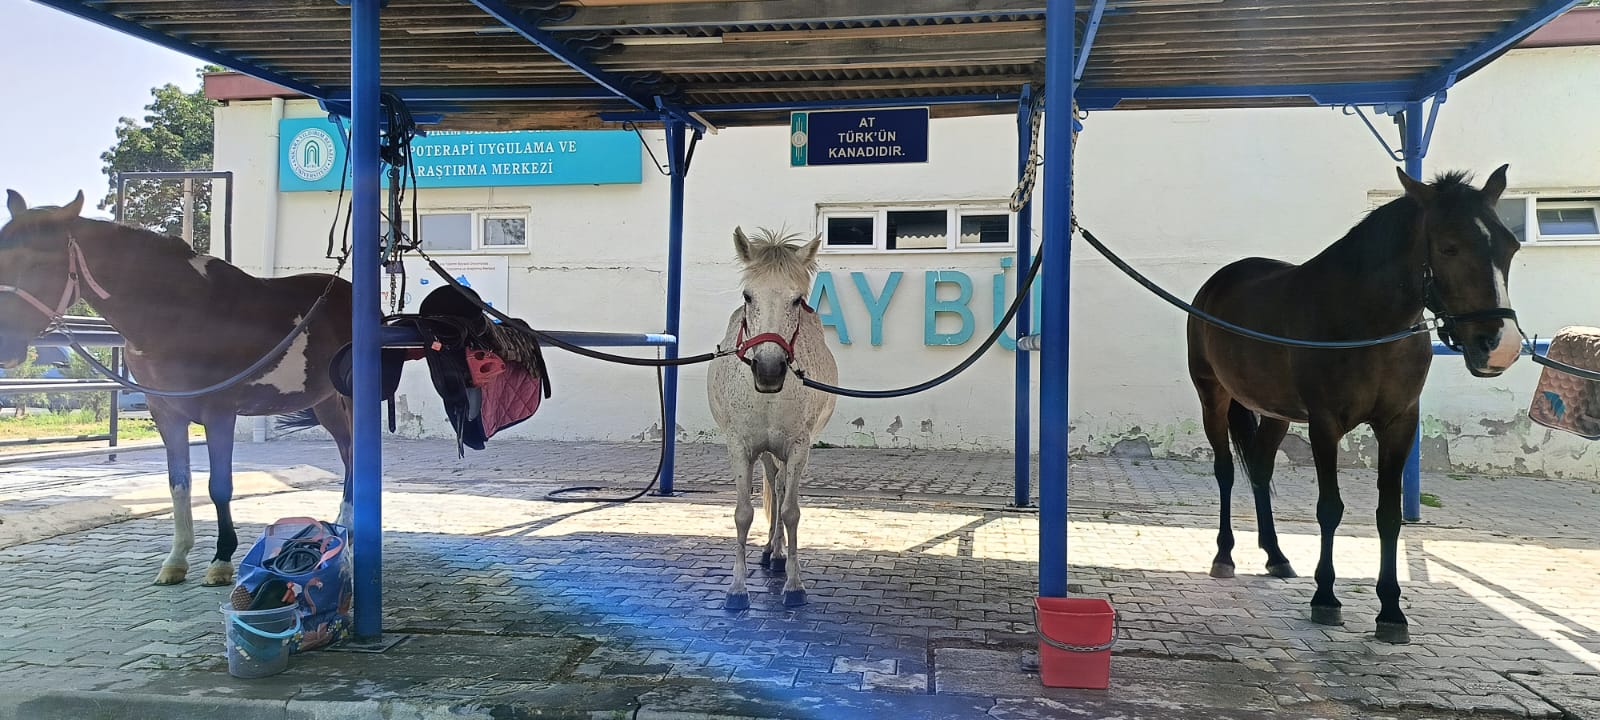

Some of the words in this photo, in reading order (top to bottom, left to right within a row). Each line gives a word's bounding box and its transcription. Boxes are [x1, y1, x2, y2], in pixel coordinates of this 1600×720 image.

[858, 117, 876, 128] AT
[838, 130, 896, 144] TÜRK'ÜN
[478, 141, 555, 155] UYGULAMA
[559, 140, 577, 153] VE
[828, 145, 906, 159] KANADIDIR.
[491, 158, 553, 176] MERKEZİ
